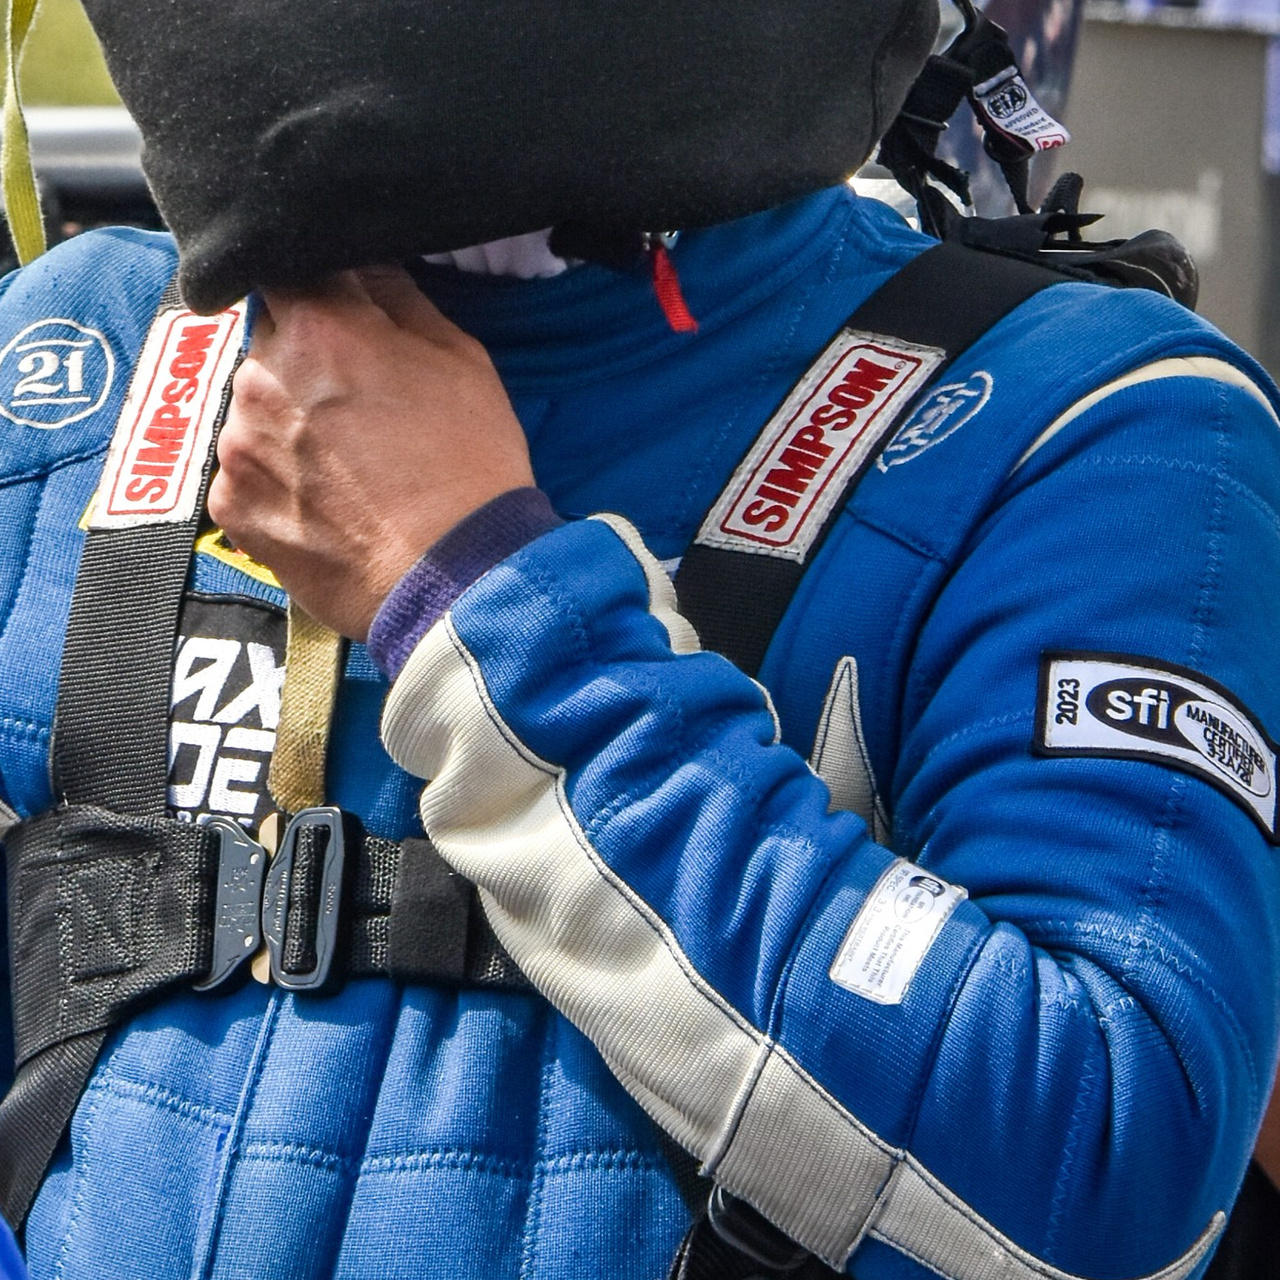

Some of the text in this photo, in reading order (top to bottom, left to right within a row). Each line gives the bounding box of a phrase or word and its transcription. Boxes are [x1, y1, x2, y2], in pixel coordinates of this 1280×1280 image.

[13, 350, 86, 397] 21
[125, 324, 220, 503] SIMPSON
[742, 357, 900, 533] SIMPSON
[171, 634, 287, 730] AX
[1055, 677, 1080, 726] 2023
[1105, 687, 1170, 730] sfi
[1186, 704, 1266, 775] MANUFACTURER
[1203, 726, 1255, 776] CERTIFIED
